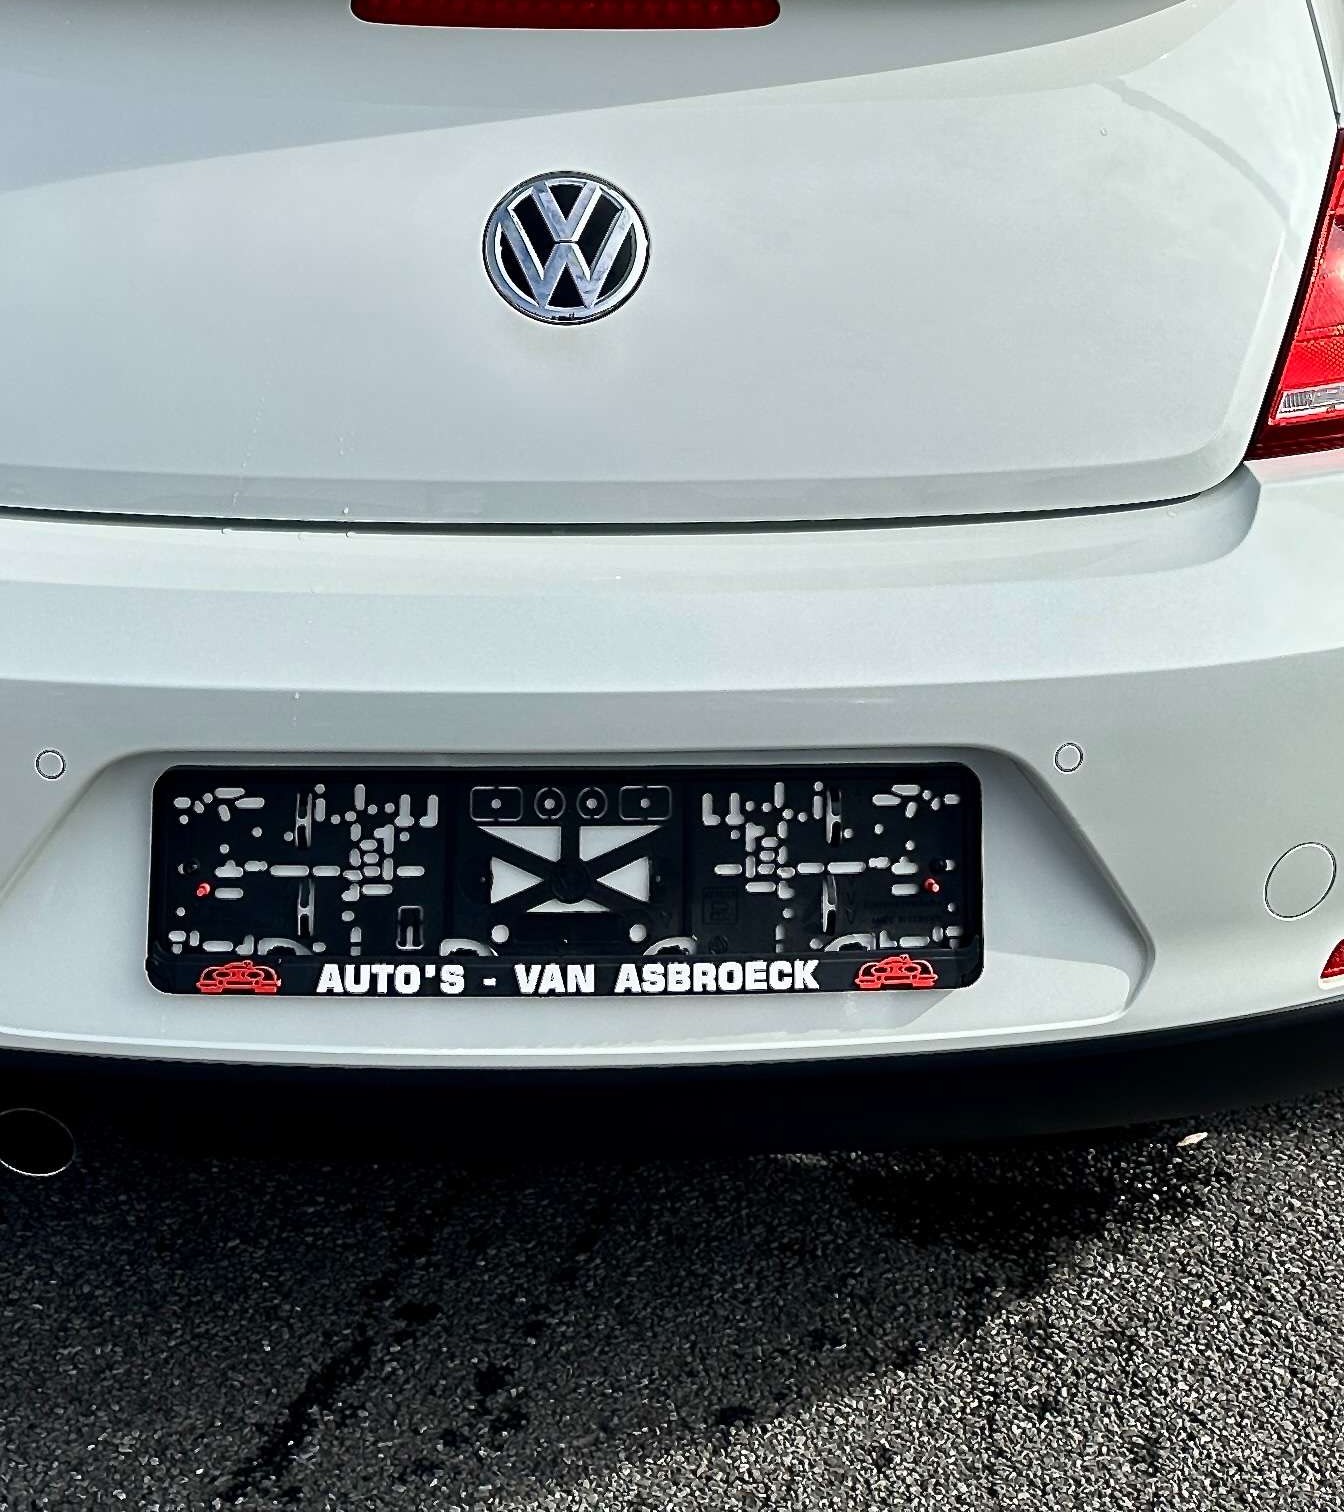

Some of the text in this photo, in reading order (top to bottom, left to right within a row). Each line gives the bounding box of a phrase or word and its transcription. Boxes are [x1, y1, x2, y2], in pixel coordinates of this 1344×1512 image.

[489, 176, 643, 316] VW
[316, 963, 465, 994] AUTO'S
[514, 963, 595, 994] VAN
[614, 959, 820, 993] ASBROECK
